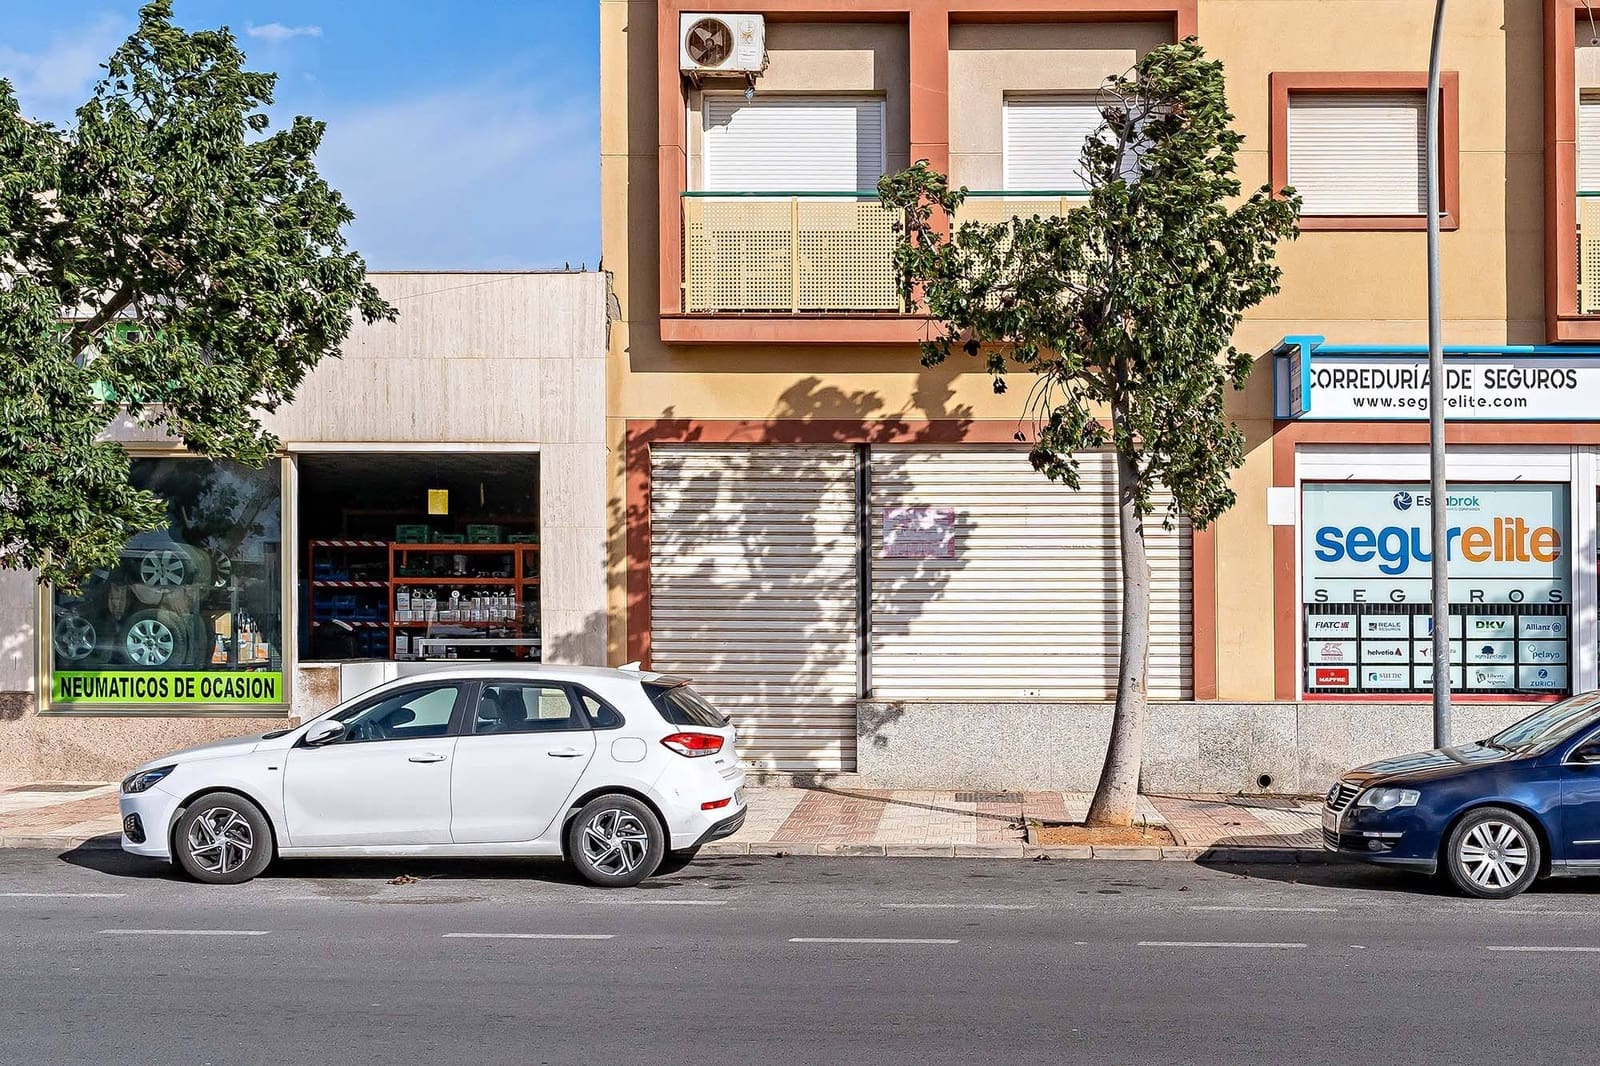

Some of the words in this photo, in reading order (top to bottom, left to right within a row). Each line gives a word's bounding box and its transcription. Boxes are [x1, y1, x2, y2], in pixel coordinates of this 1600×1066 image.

[1446, 369, 1472, 389] DE
[1484, 369, 1577, 389] SEGUROS
[1353, 395, 1527, 411] www.segelite.com
[1416, 495, 1480, 506] Esbrok
[1314, 589, 1563, 603] SEGROS
[1315, 621, 1340, 629] FIATC
[1475, 621, 1506, 629] DKV
[1525, 623, 1551, 631] Allianz
[1367, 648, 1394, 656] helvetia
[1532, 650, 1560, 661] pelayo
[60, 677, 169, 698] NEUMATICOS
[174, 677, 195, 698] DE
[200, 677, 275, 698] OCASION
